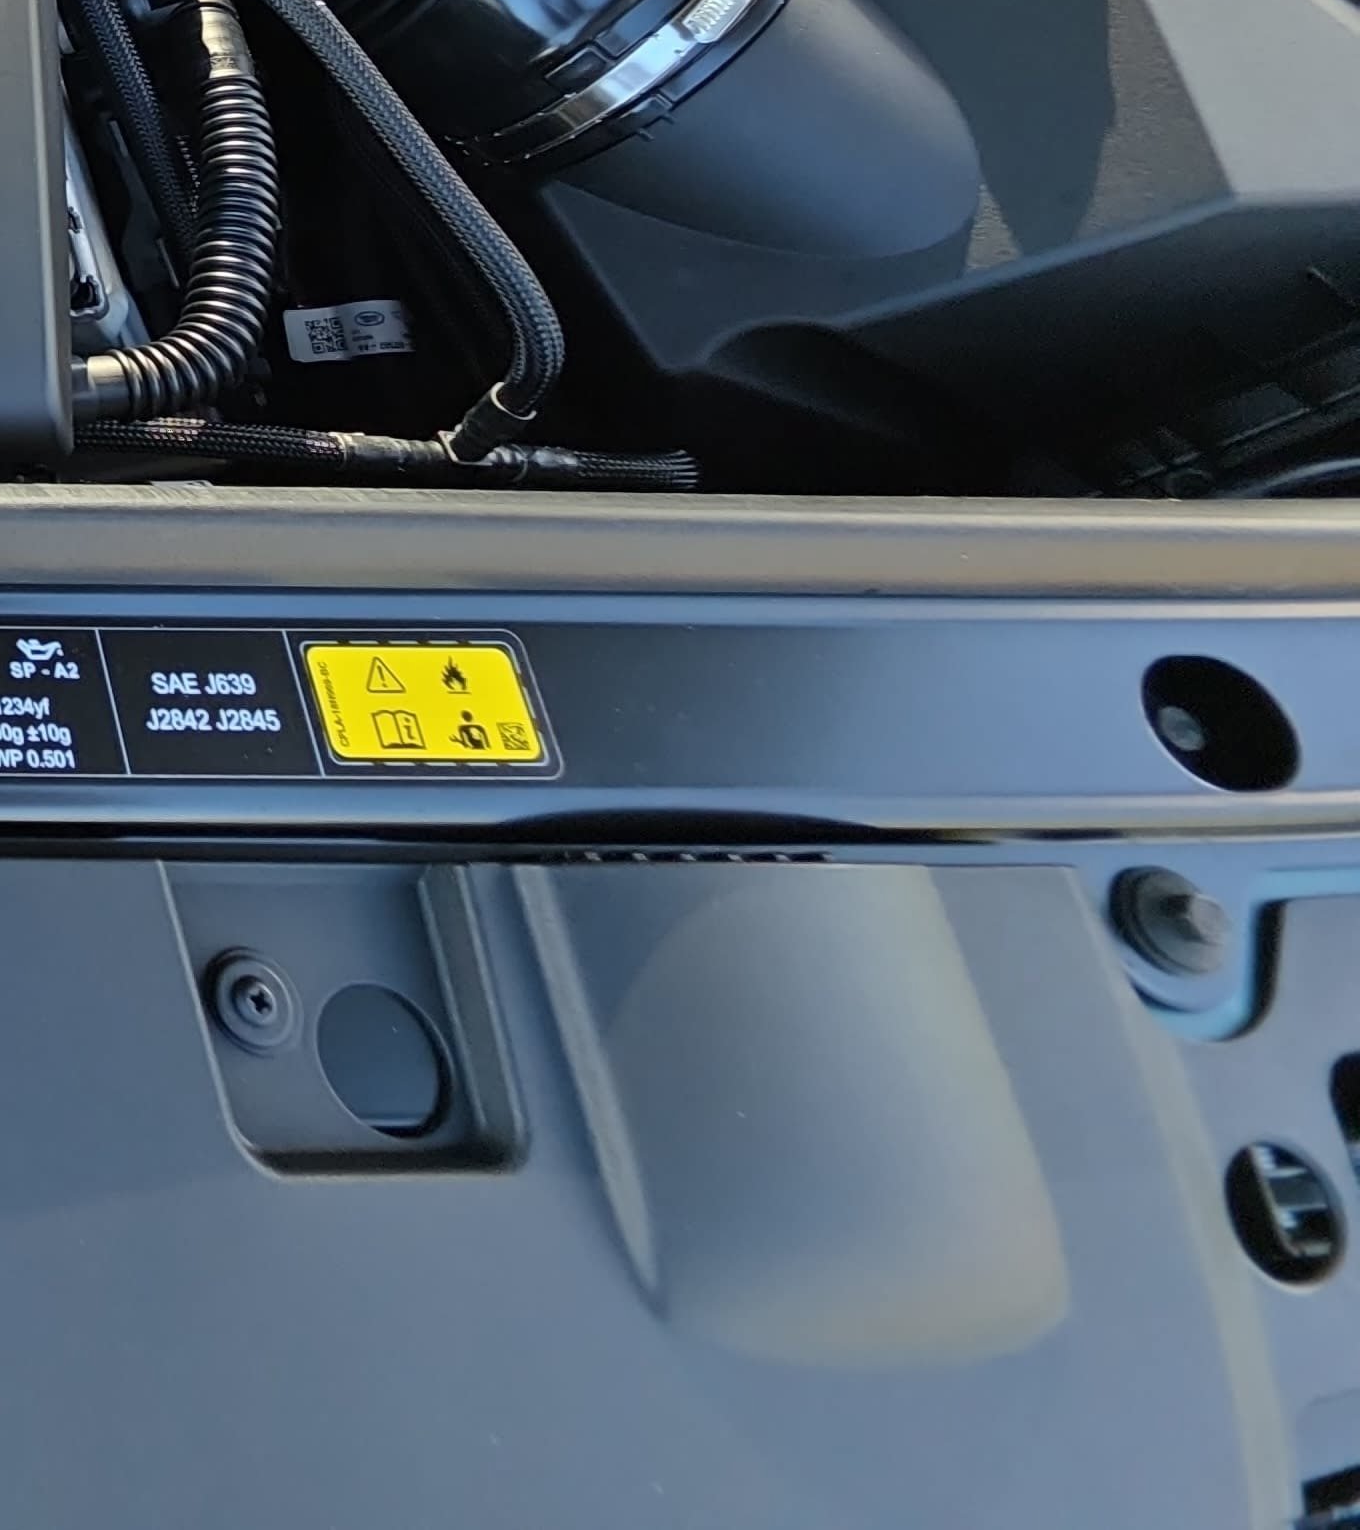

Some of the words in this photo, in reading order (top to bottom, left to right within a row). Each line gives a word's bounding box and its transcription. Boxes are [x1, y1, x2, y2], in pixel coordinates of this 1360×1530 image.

[150, 671, 202, 695] SAE
[204, 672, 257, 696] J639
[145, 707, 213, 731] J2842
[215, 707, 281, 732] J2845
[26, 723, 73, 747] ±10g
[26, 748, 76, 768] 0.501
